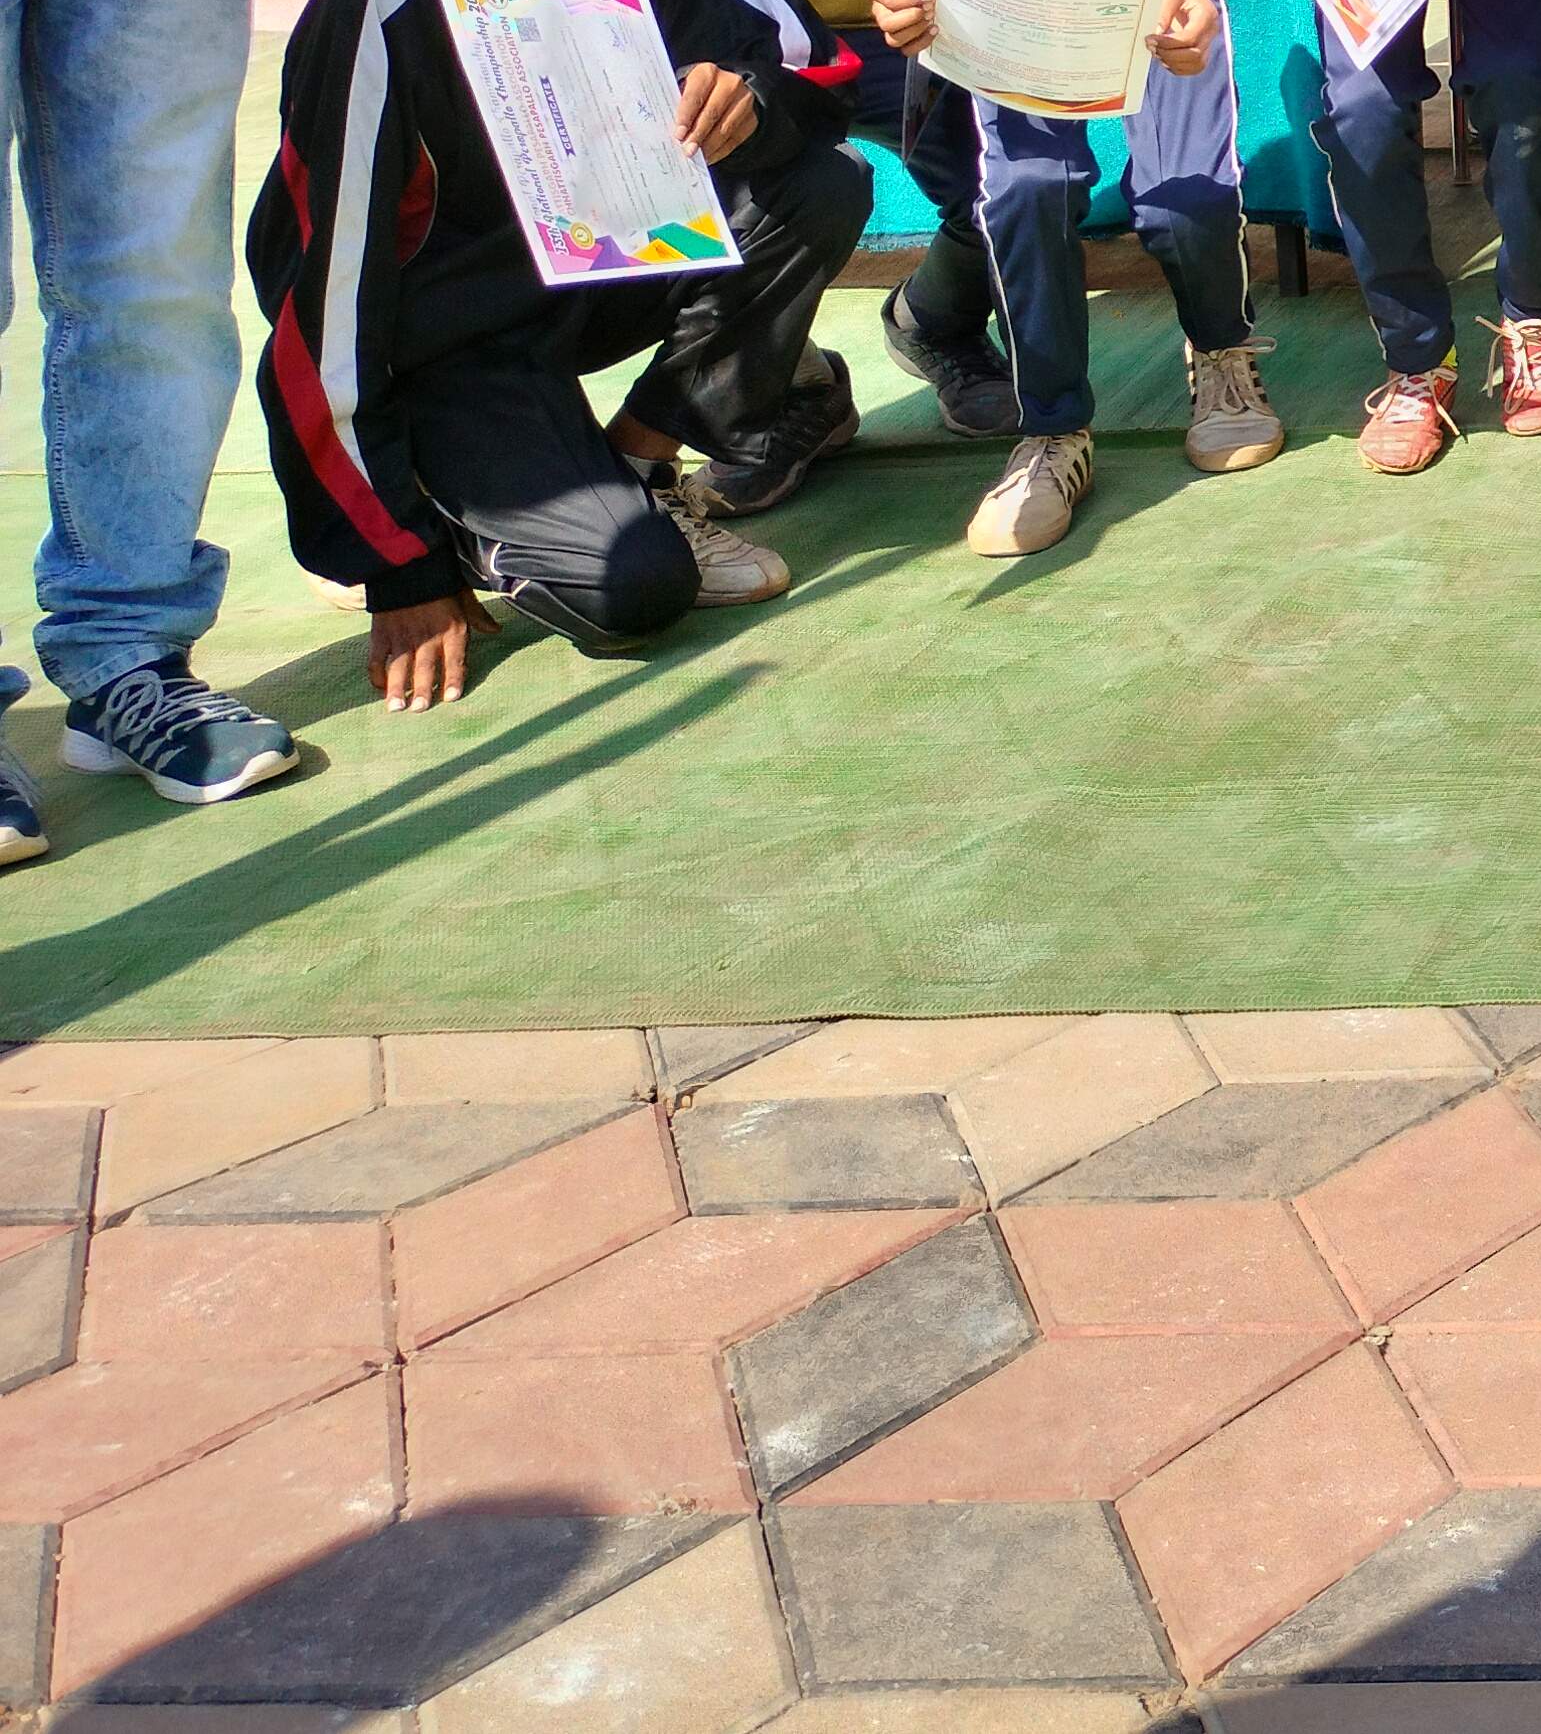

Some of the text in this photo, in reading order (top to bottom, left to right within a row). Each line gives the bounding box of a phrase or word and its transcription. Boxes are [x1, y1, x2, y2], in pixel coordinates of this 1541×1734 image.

[479, 16, 509, 102] Championship
[501, 16, 528, 83] ASSOCIATION
[522, 86, 549, 140] PESAPALLO
[541, 81, 572, 151] CERTIFICATE
[529, 167, 558, 222] National
[546, 219, 569, 256] 13th
